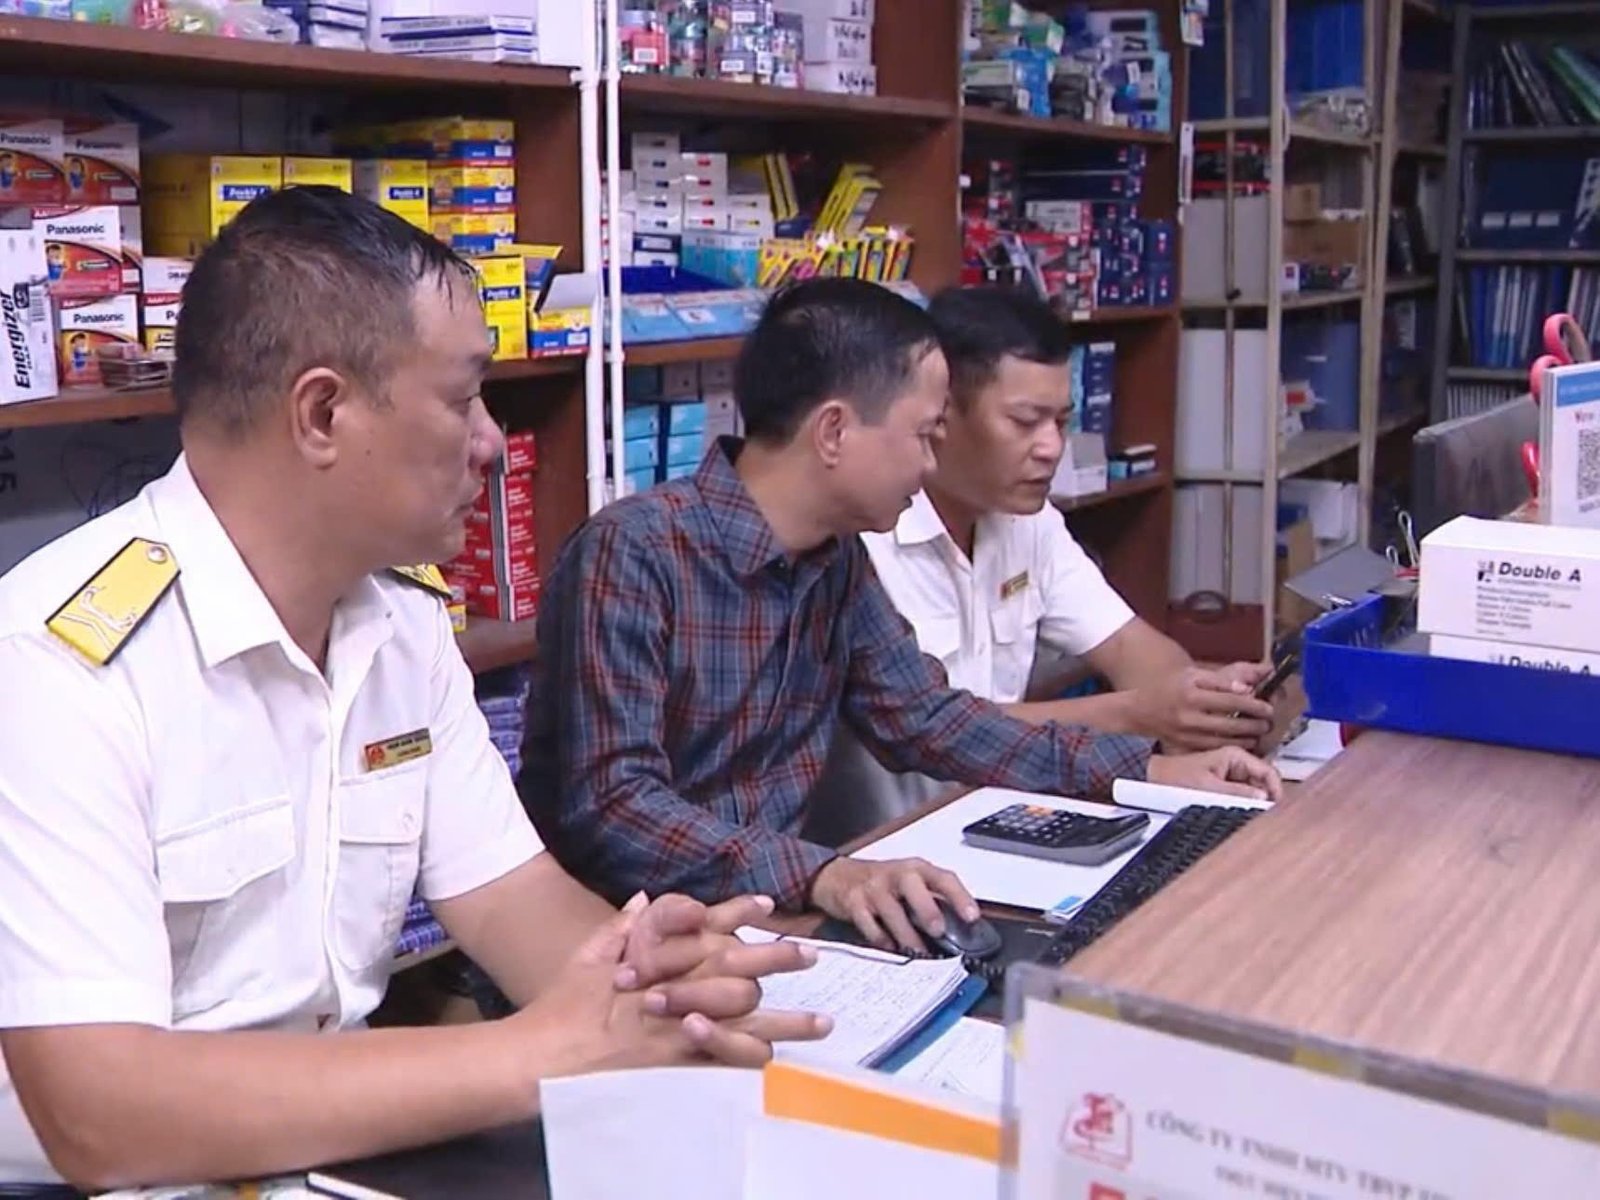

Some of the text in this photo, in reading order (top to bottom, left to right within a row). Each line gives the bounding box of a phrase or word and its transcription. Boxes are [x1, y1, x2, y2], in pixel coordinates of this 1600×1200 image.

[46, 223, 105, 235] Panasonic
[73, 313, 125, 323] Panasonic
[0, 288, 31, 388] Energizer
[1499, 561, 1581, 582] Double A
